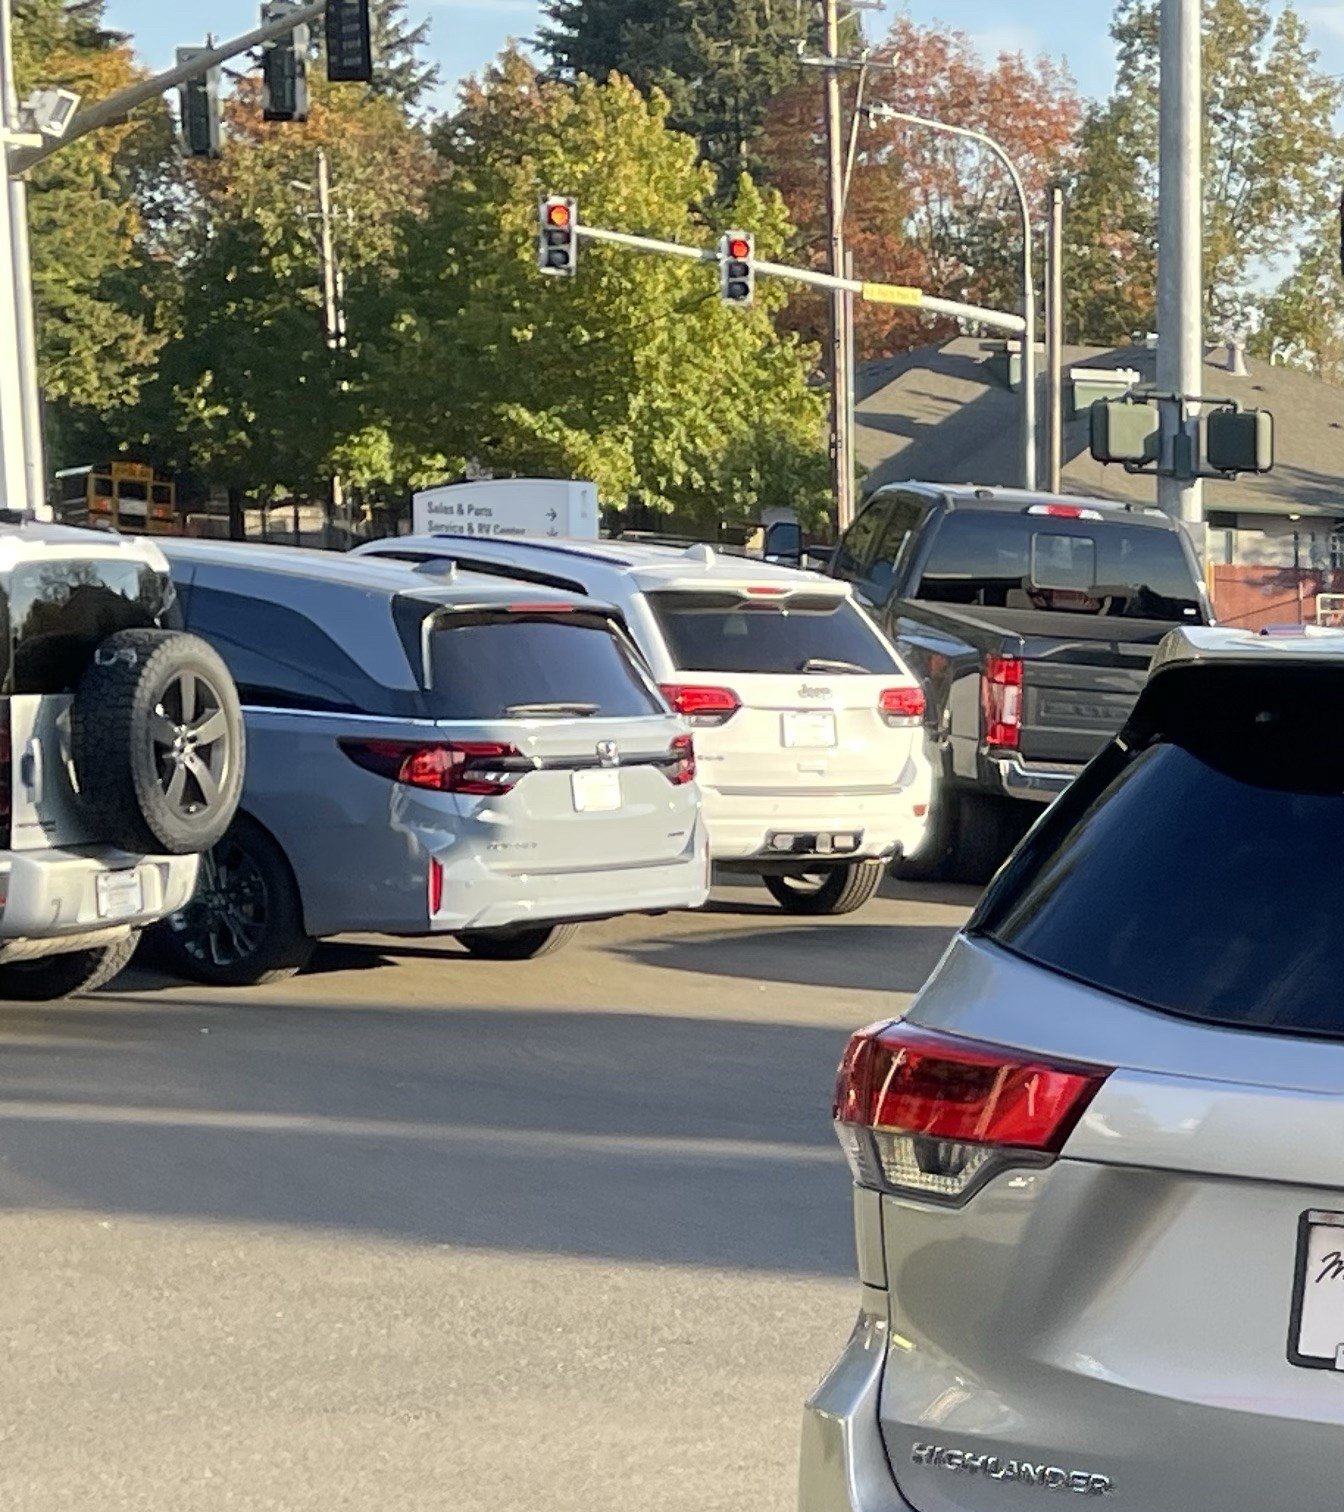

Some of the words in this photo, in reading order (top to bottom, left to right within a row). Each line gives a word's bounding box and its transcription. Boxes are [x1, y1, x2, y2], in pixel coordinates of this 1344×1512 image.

[427, 501, 454, 515] Sales
[456, 503, 464, 516] &
[467, 503, 493, 518] Parts
[427, 519, 464, 535] Service
[467, 522, 475, 535] &
[912, 1442, 1117, 1497] HIGHLANDER
